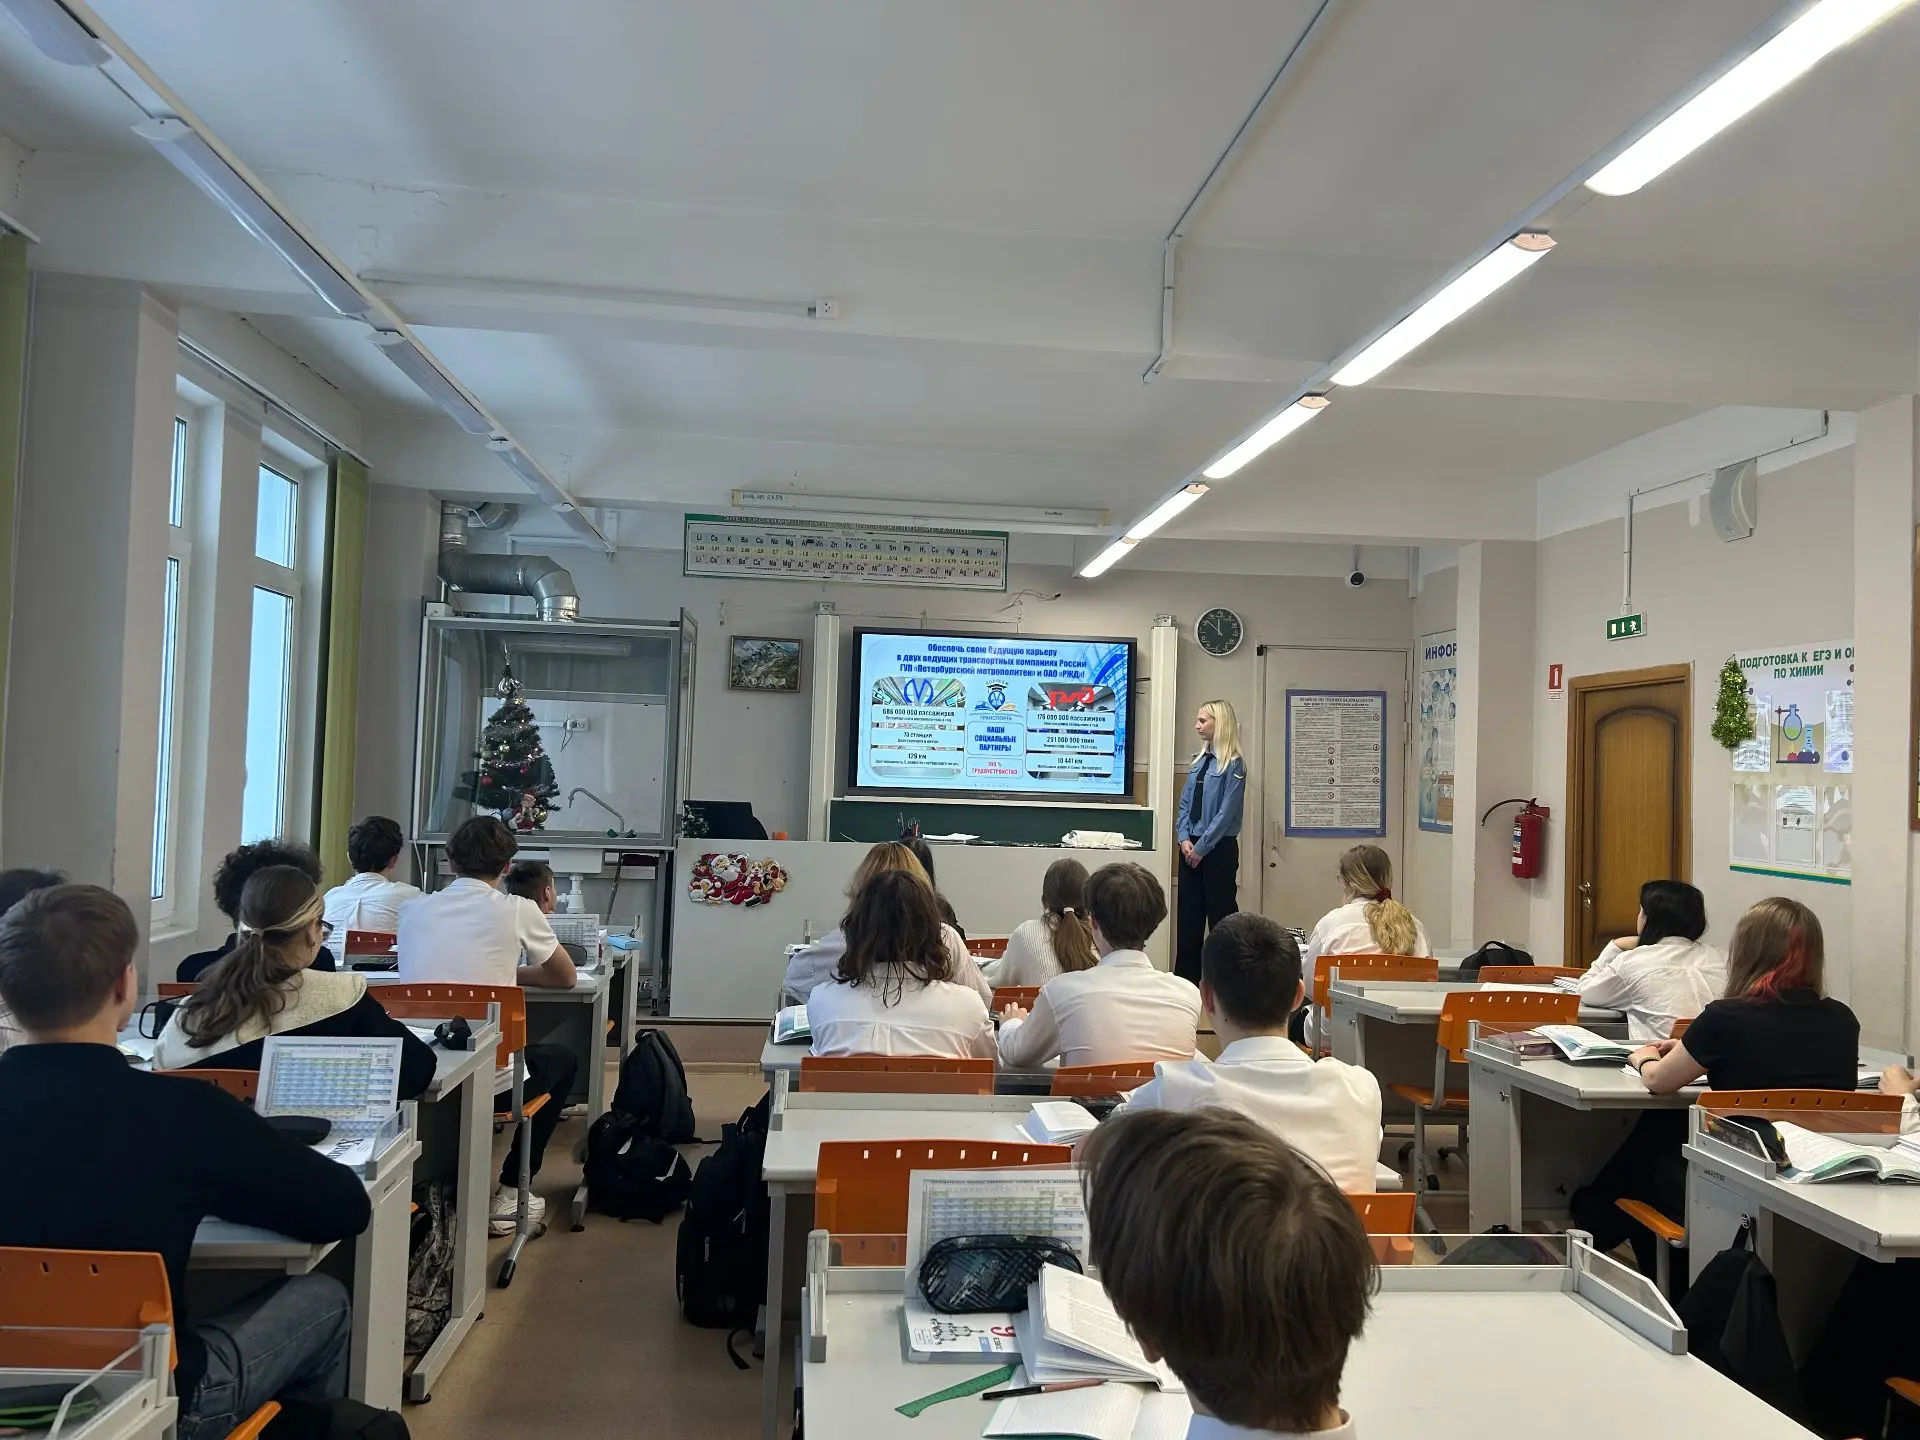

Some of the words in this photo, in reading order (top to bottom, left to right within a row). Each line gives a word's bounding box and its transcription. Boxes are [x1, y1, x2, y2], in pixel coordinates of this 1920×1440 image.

[988, 646, 1024, 655] будущую
[1426, 643, 1456, 660] ИНФОР
[1740, 653, 1798, 669] ПОДГОТОВКА
[1802, 652, 1808, 662] К
[1814, 650, 1831, 661] ЕГЭ
[1834, 649, 1841, 659] И
[1845, 646, 1854, 658] О
[959, 657, 1014, 665] транспортных
[1774, 668, 1786, 679] ПО
[1789, 665, 1824, 678] ХИМИИ
